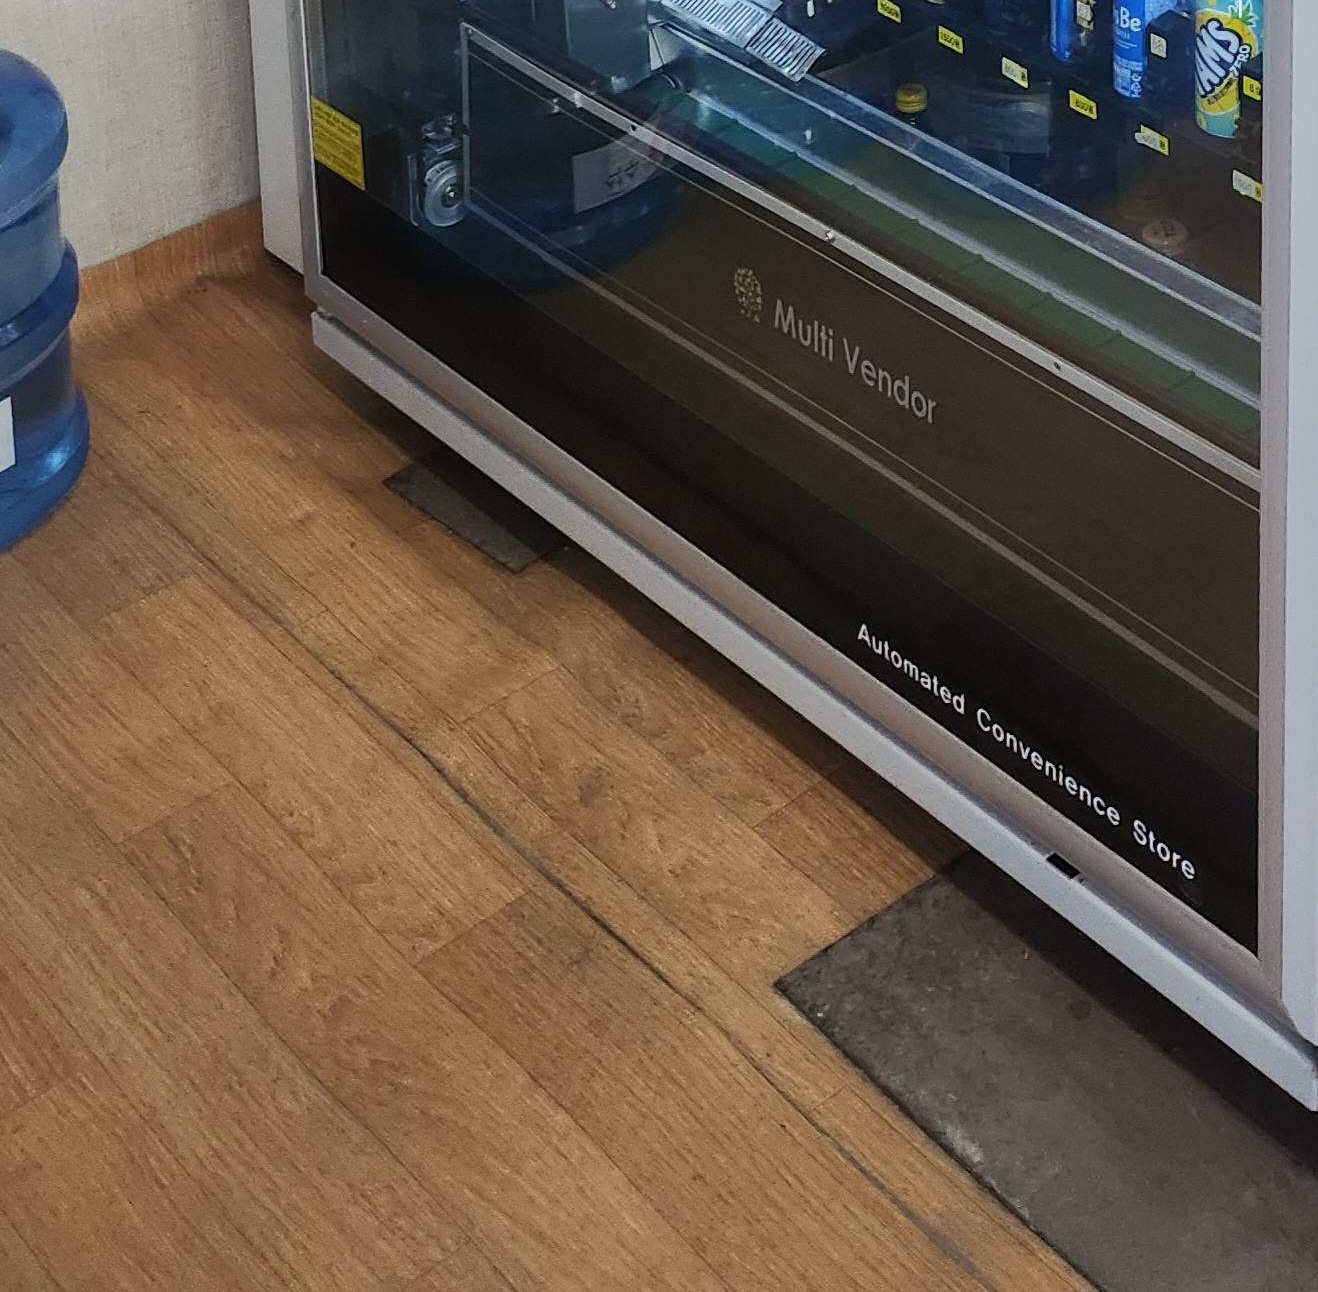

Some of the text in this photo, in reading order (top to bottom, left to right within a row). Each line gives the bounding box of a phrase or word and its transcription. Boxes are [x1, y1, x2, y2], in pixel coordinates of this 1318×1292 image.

[1196, 17, 1241, 97] AMS
[1230, 43, 1251, 77] ZERO
[774, 299, 938, 424] Multi Vendor
[857, 623, 1197, 882] Automated Convenience Store
